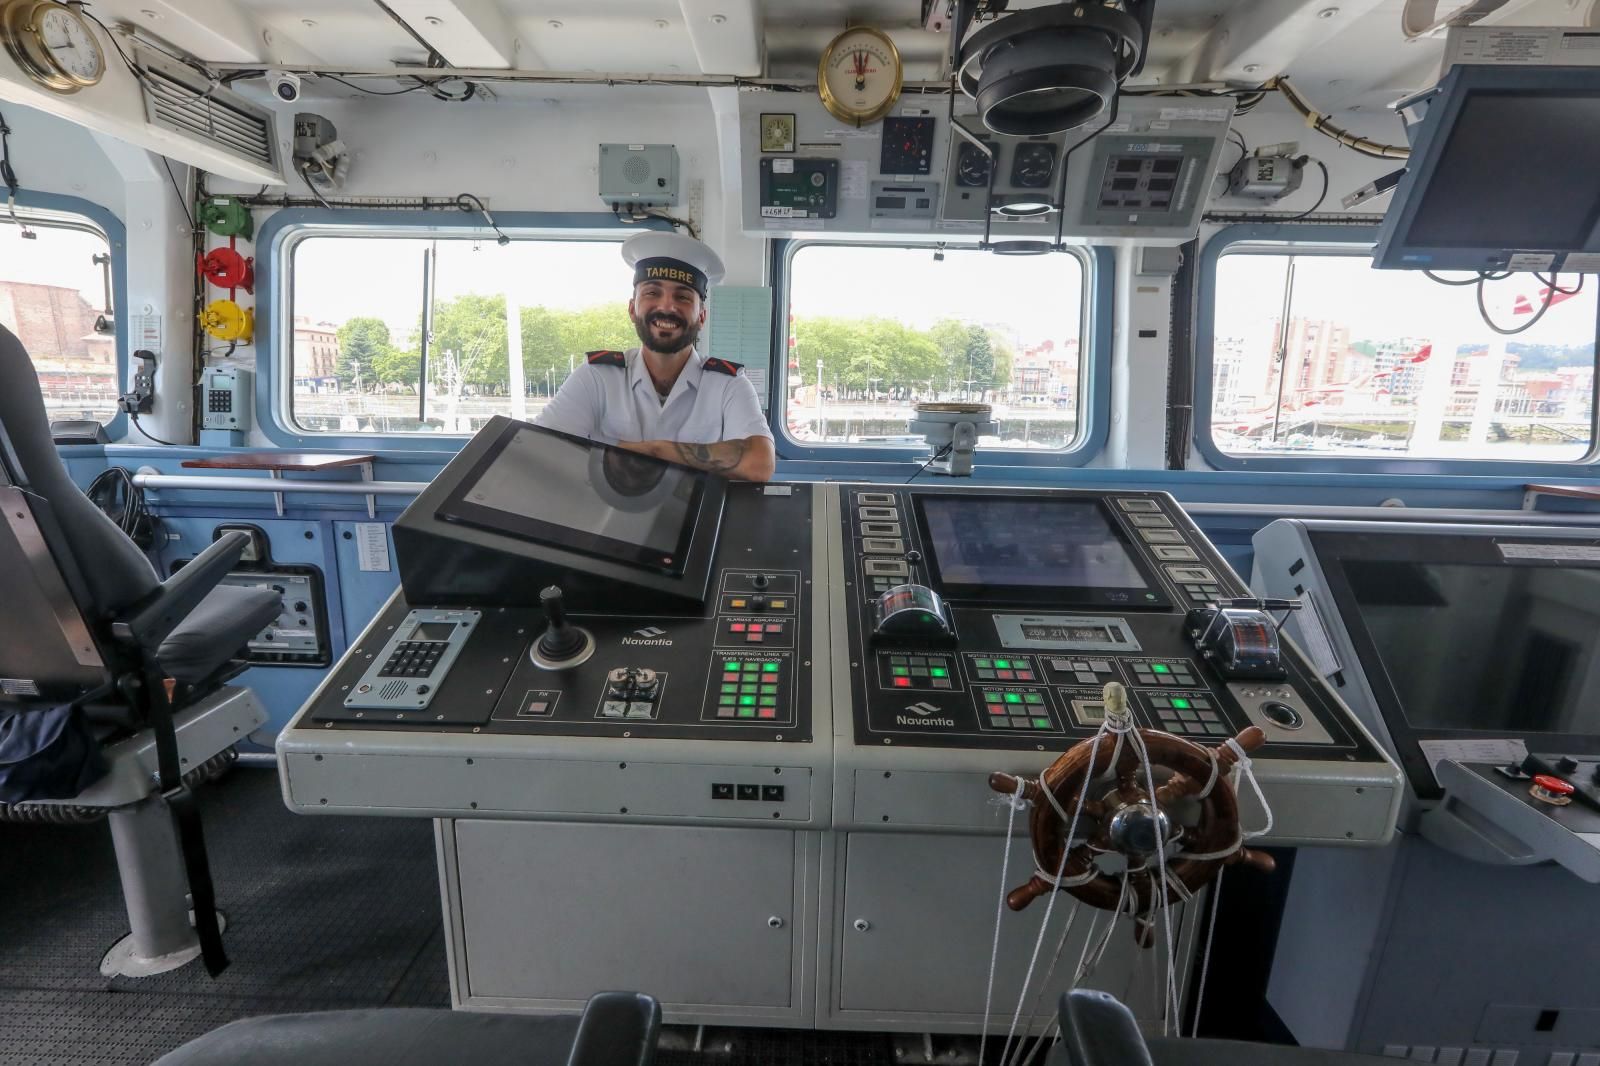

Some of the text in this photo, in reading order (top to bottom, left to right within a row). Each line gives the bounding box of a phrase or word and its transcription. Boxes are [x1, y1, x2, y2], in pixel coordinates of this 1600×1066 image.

[646, 267, 693, 284] TAMBRE
[621, 637, 673, 646] Navantia
[896, 715, 954, 727] Navantia
